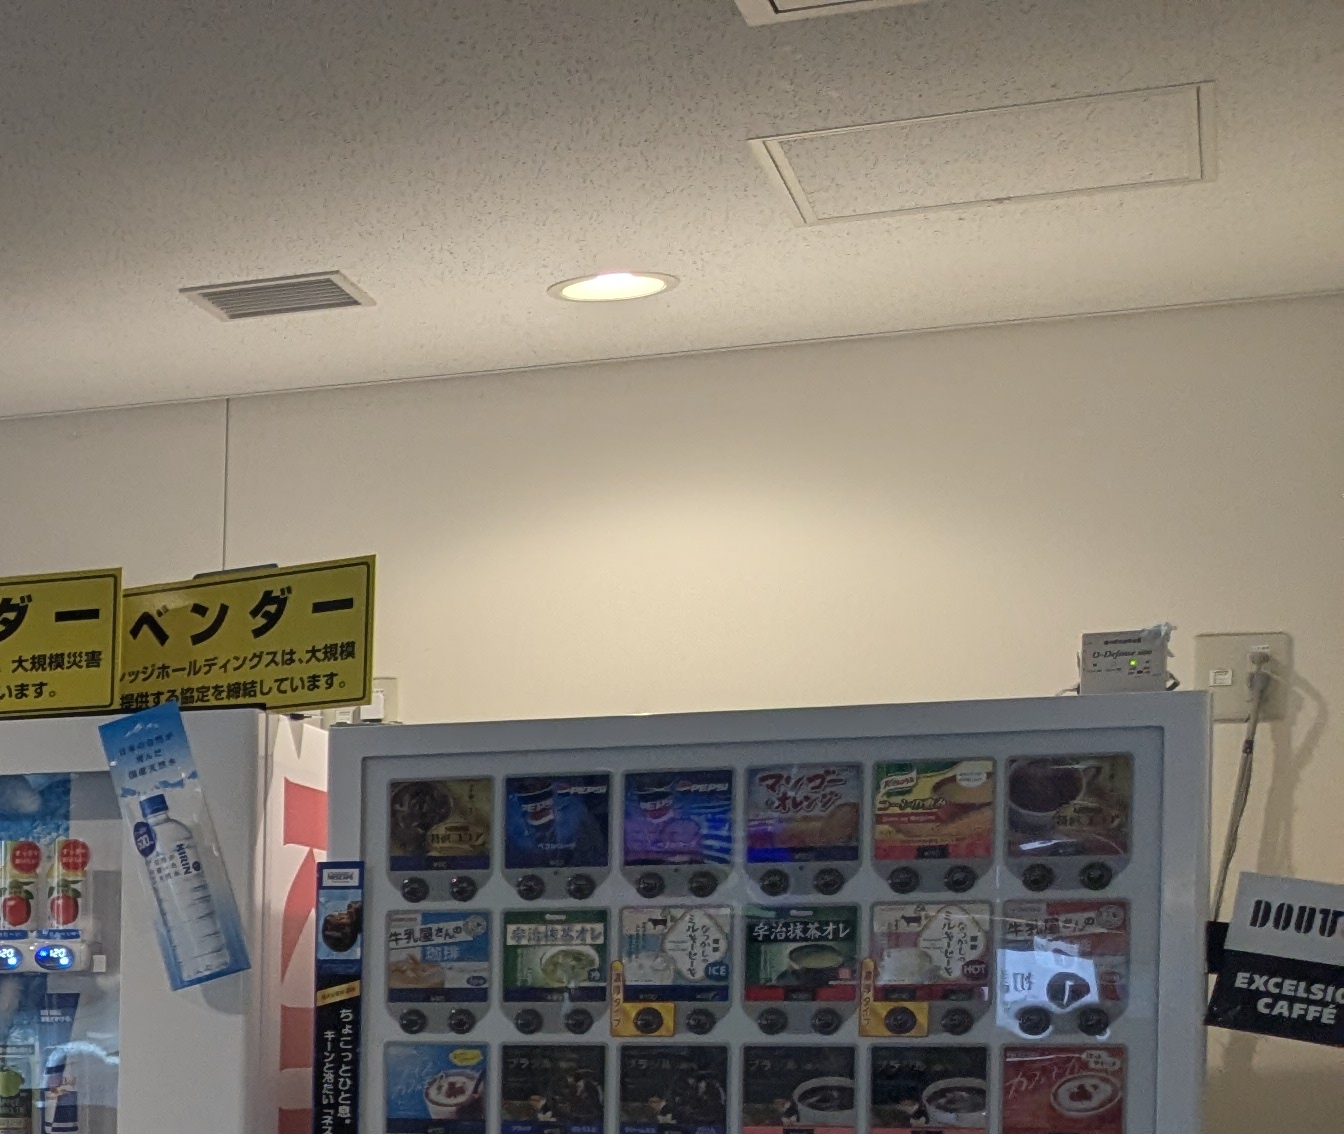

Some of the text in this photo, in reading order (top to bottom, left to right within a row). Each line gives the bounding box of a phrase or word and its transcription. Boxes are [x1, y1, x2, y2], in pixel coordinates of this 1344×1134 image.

[128, 585, 354, 647] ベンダー
[752, 923, 851, 940] 宇治抹茶オレ
[1249, 899, 1344, 940] DOUT
[388, 924, 461, 945] 牛乳屋さんの
[707, 966, 727, 976] ICE
[962, 962, 988, 975] HOT
[1256, 997, 1338, 1024] CAFFÉ
[336, 1007, 355, 1126] ちょこっとひと息。
